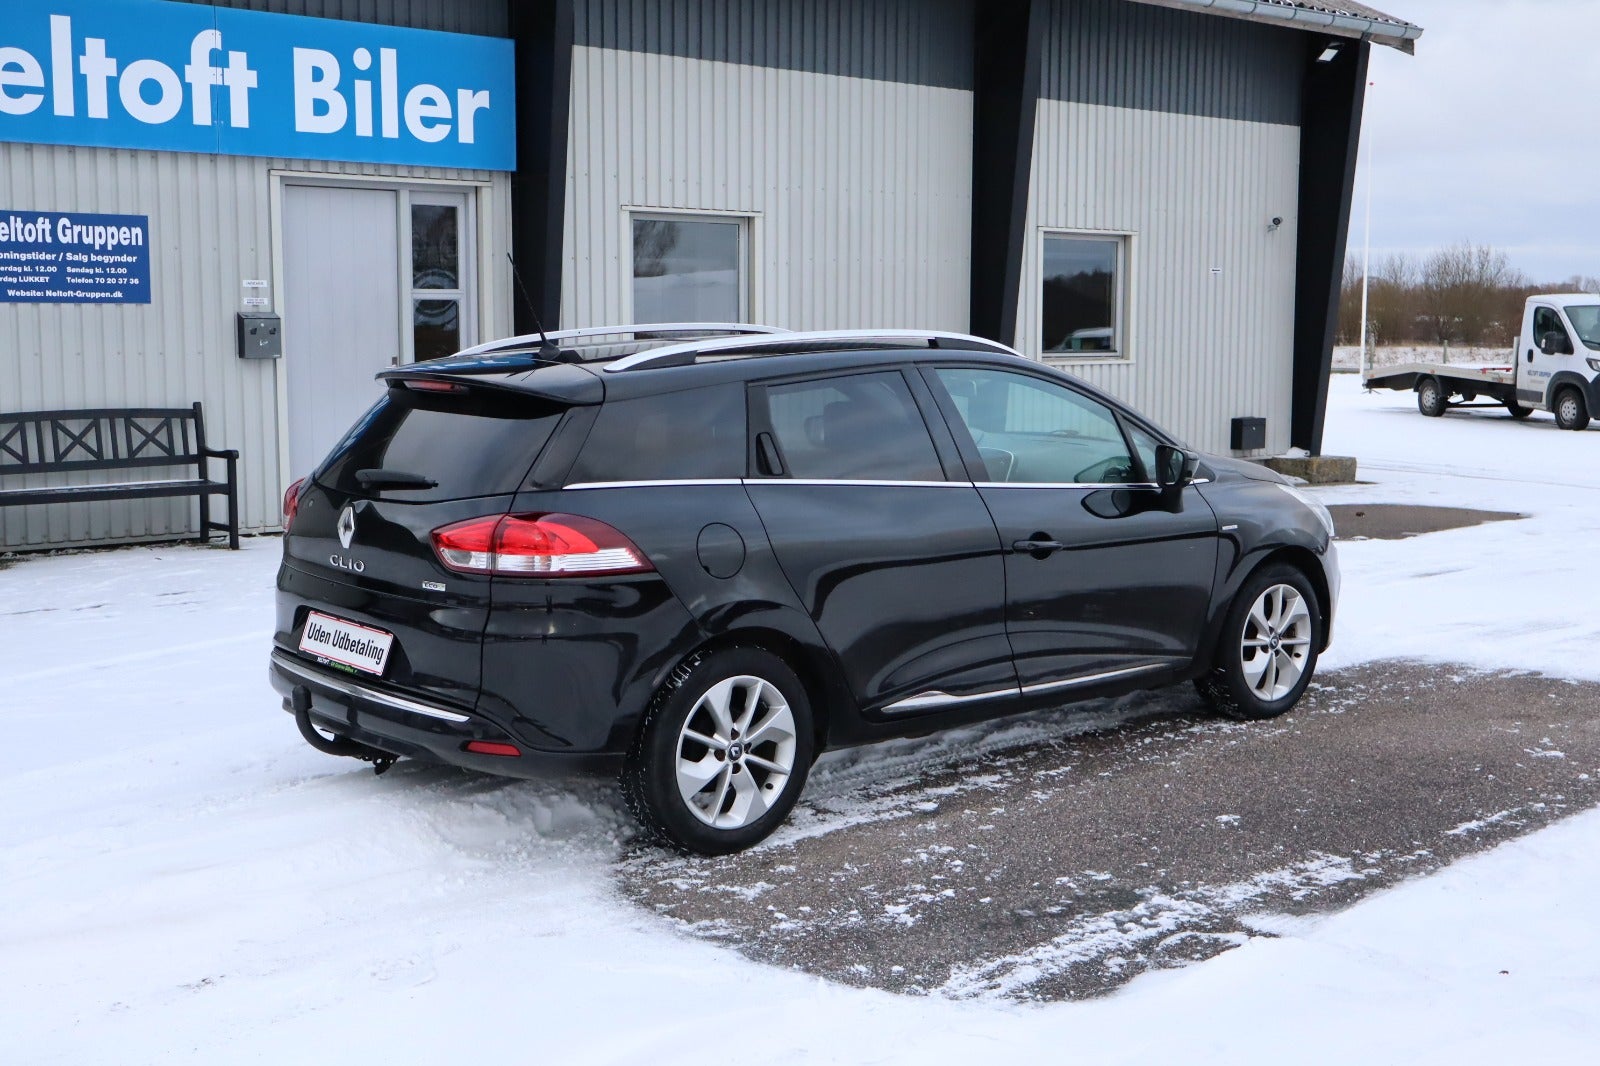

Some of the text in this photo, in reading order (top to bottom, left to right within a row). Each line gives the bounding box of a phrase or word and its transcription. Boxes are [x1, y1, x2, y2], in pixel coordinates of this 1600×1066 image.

[0, 14, 490, 144] eltoft Biler
[57, 217, 143, 251] Gruppen
[58, 252, 64, 262] /
[66, 252, 88, 263] Salg
[91, 253, 138, 264] begynder
[7, 289, 123, 299] Website: Neltoft-Gruppen.dk
[329, 554, 365, 572] CLIO
[307, 622, 331, 645] Uden
[332, 629, 385, 665] Udbetaling
